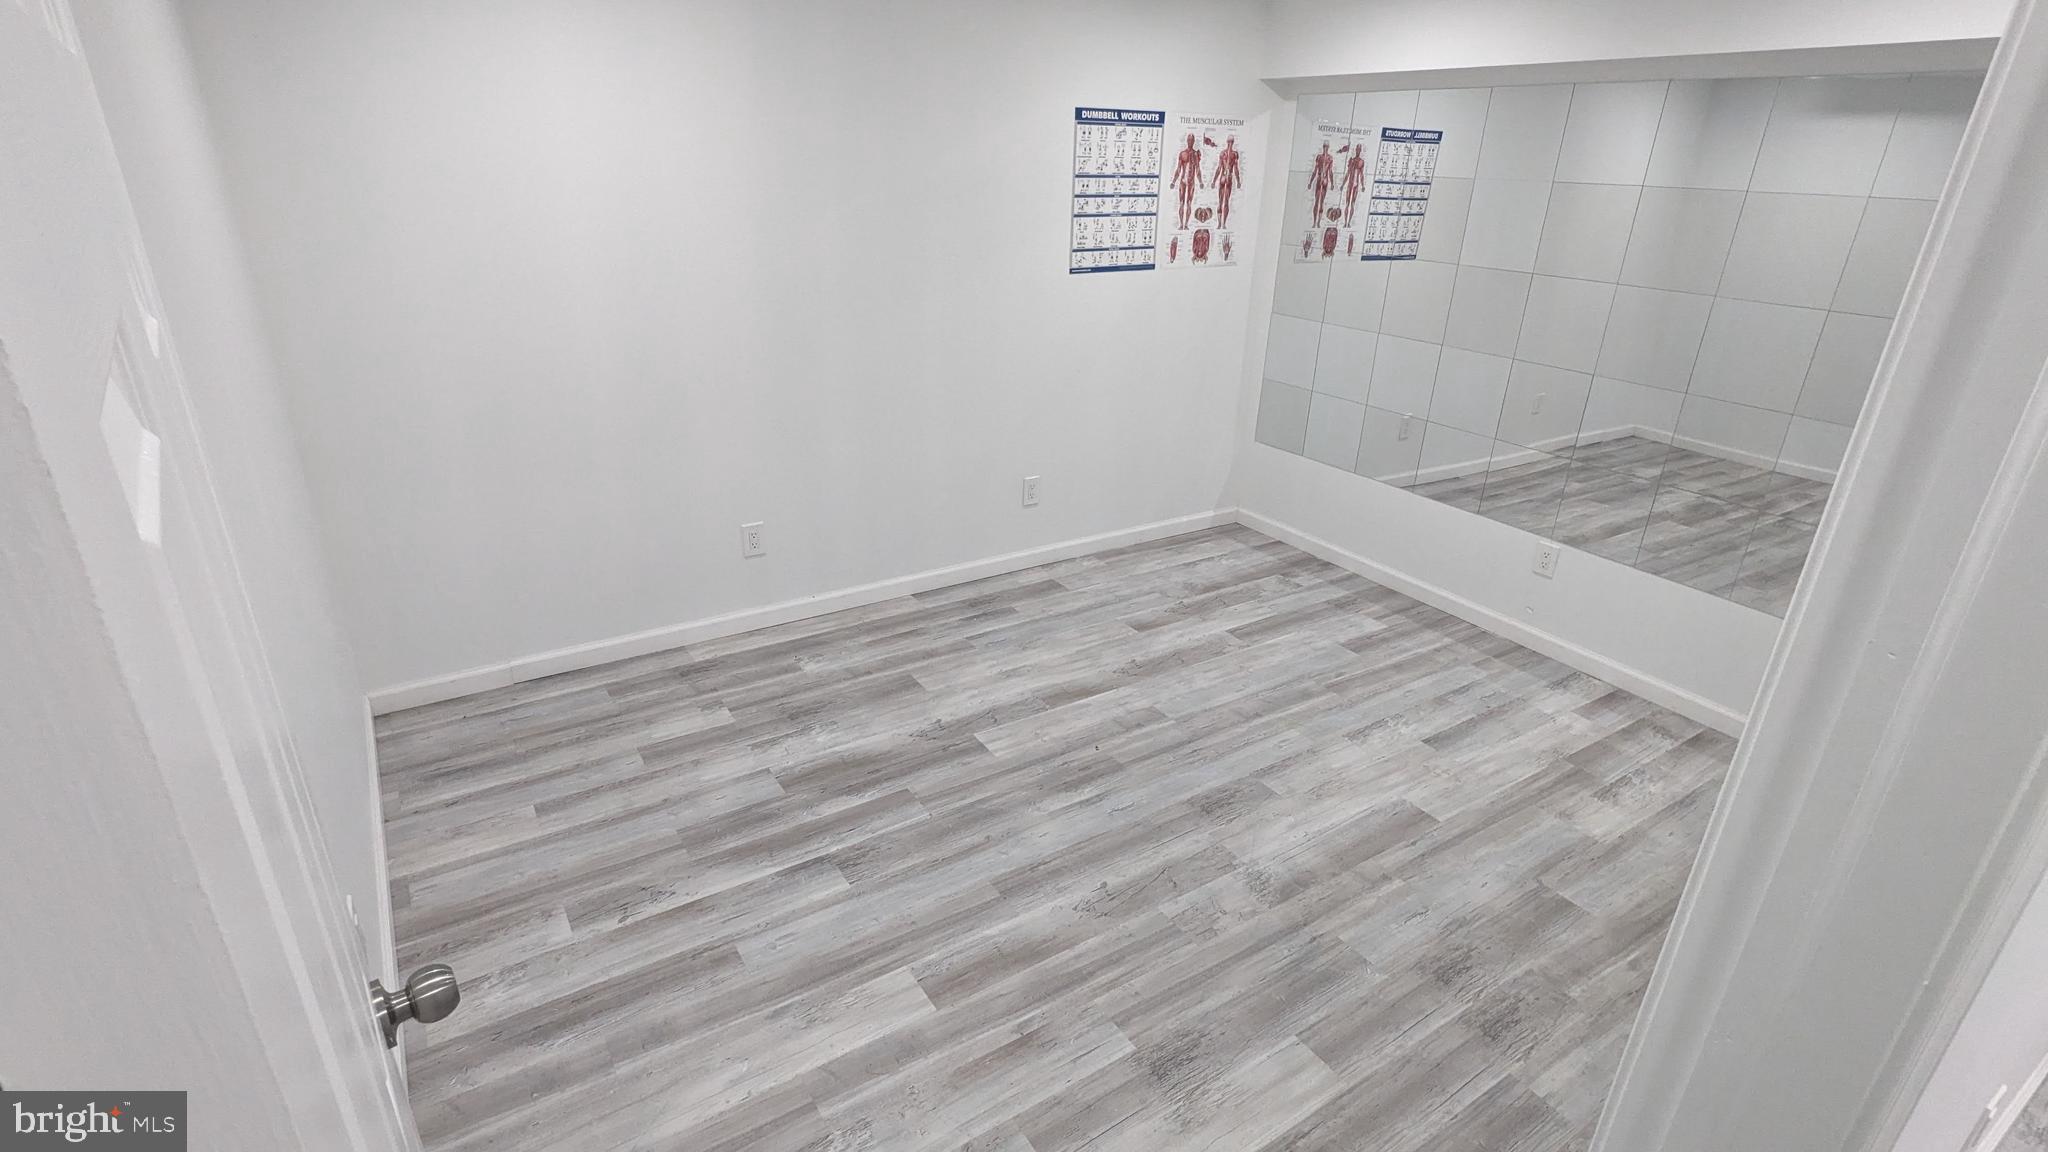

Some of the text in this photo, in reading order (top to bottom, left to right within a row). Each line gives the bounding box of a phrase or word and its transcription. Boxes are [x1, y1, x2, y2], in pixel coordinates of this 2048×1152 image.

[1081, 110, 1160, 121] DUMBBELL WORKOUTS
[1180, 116, 1191, 124] THE
[1192, 117, 1222, 126] MUSCULAR
